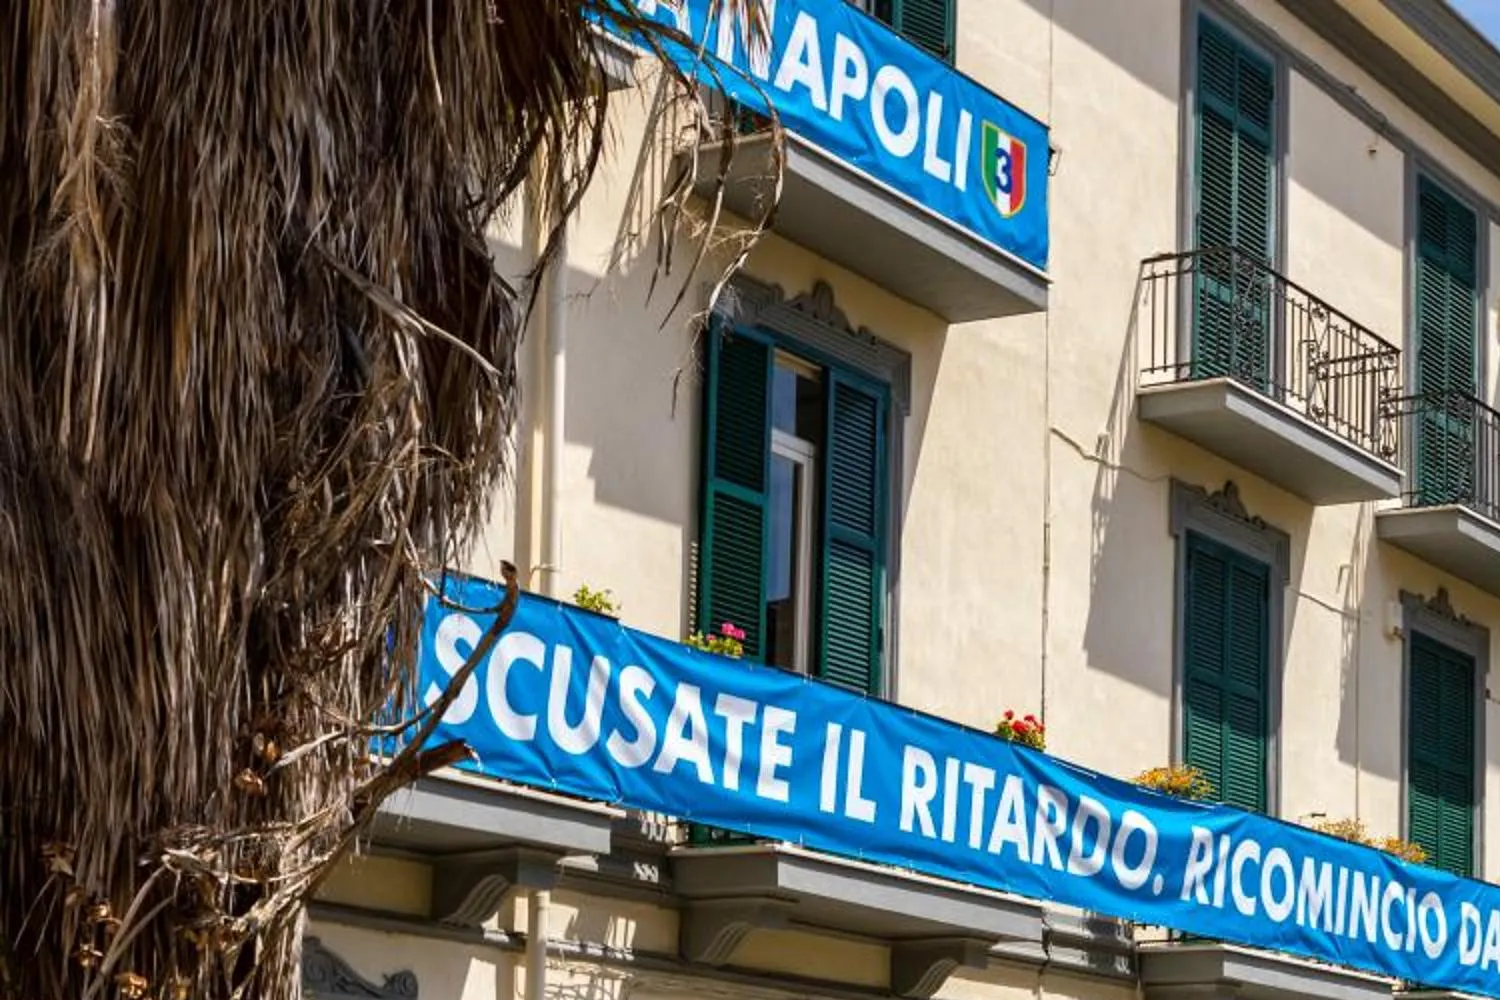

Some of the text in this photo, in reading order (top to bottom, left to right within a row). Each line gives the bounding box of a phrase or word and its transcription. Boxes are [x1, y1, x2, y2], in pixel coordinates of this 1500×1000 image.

[995, 147, 1014, 195] 3
[424, 613, 798, 802] SCUSATE
[820, 723, 878, 824] IL
[899, 747, 1163, 896] RITARDO.
[1180, 825, 1448, 960] RICOMINCIO
